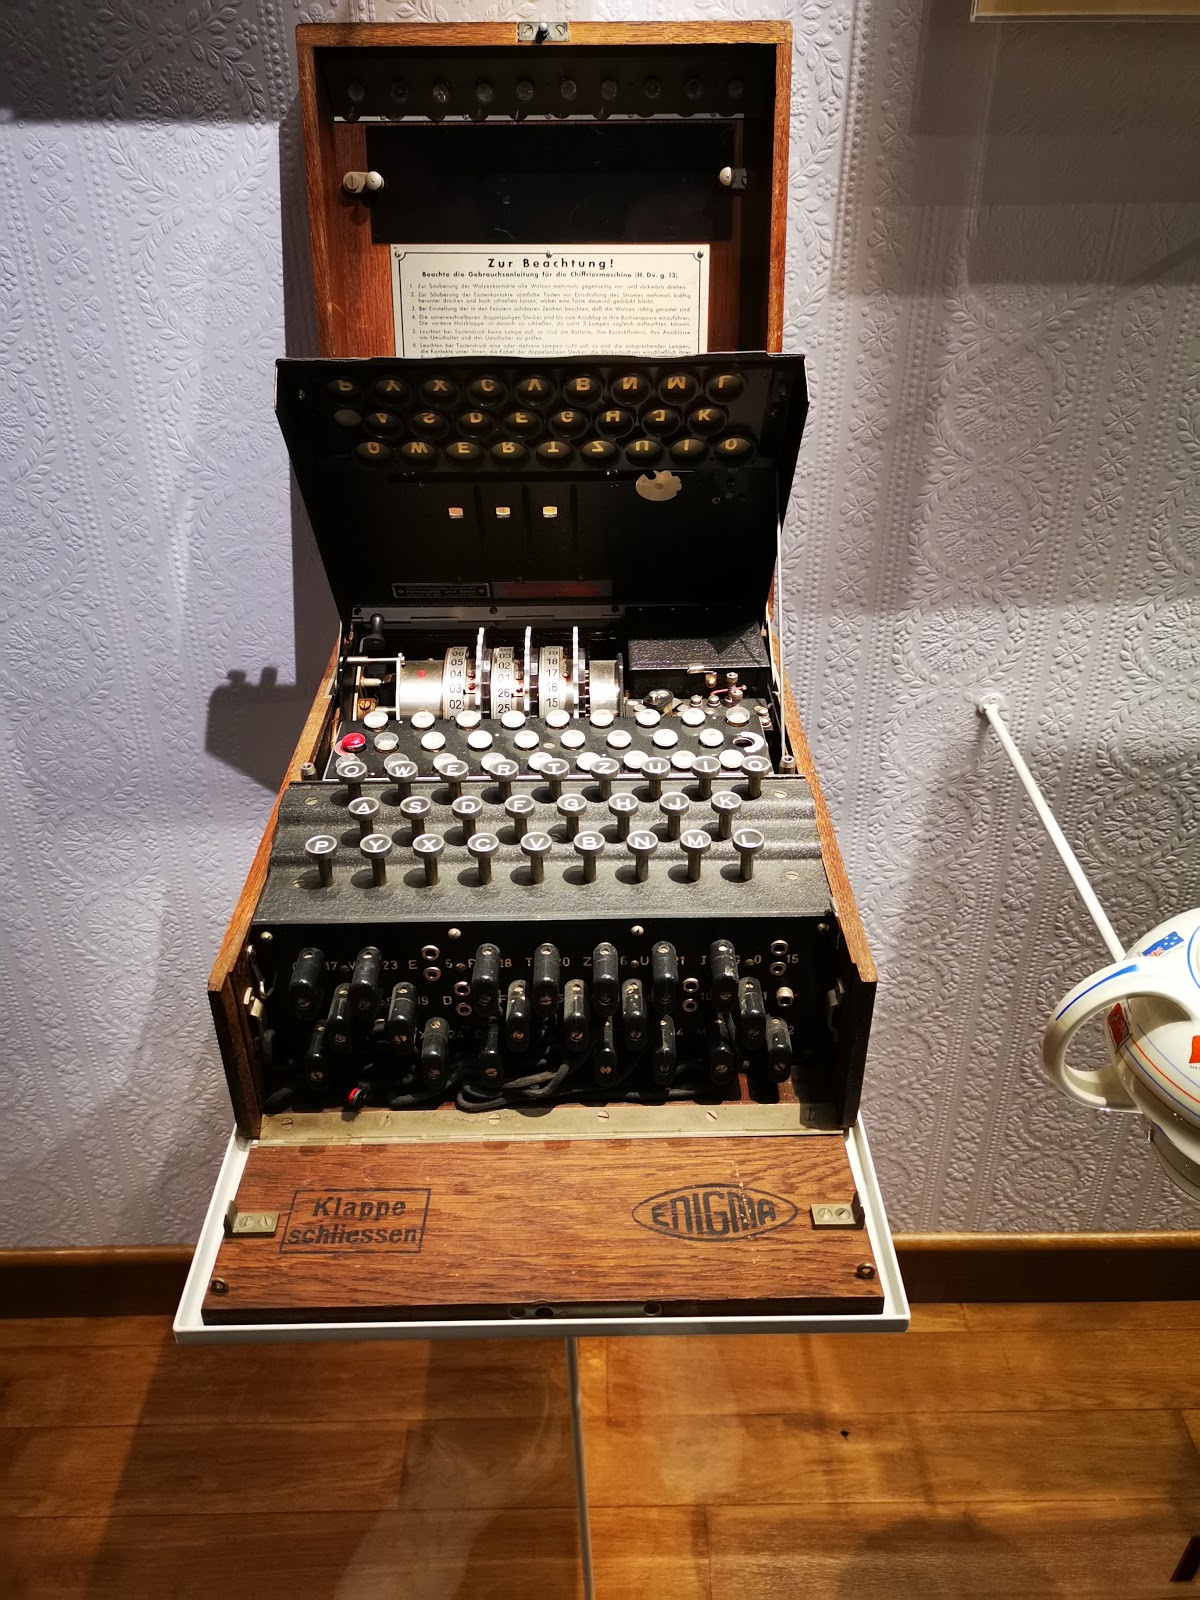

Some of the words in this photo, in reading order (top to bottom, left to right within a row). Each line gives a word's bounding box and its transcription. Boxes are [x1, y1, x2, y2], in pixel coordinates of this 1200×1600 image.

[488, 258, 514, 268] Zur
[522, 258, 614, 271] Beachtung!
[467, 271, 539, 280] Gebrauchsanleitung
[570, 271, 632, 279] Chiffriermaschine
[634, 271, 644, 281] (H.
[646, 271, 658, 279] Dv.
[659, 273, 666, 281] g.
[498, 661, 511, 670] 02
[450, 670, 462, 679] 04
[498, 674, 510, 682] 01
[546, 669, 557, 677] 17
[449, 683, 462, 694] 03
[546, 682, 557, 692] 16
[498, 688, 510, 698] 26
[449, 699, 462, 710] 02
[546, 698, 558, 708] 15
[498, 704, 510, 714] 25
[395, 766, 411, 775] W
[448, 765, 460, 775] E
[497, 765, 510, 774] R
[548, 764, 560, 773] T
[599, 764, 611, 773] Z
[649, 763, 661, 772] U
[704, 762, 708, 771] I
[357, 803, 370, 814] A
[409, 802, 421, 812] S
[461, 802, 475, 812] D
[514, 801, 527, 812] F
[564, 799, 579, 809] G
[617, 799, 631, 809] H
[668, 798, 681, 808] J
[720, 797, 734, 807] K
[315, 841, 329, 852] P
[369, 840, 384, 851] Y
[422, 840, 436, 850] X
[476, 839, 490, 850] C
[529, 838, 544, 849] V
[583, 837, 598, 848] B
[635, 837, 649, 848] N
[688, 836, 703, 846] M
[742, 835, 756, 845] L
[324, 961, 338, 971] 17
[382, 961, 398, 970] 23
[408, 960, 418, 970] E
[444, 959, 453, 969] 5
[582, 957, 593, 967] Z
[639, 955, 649, 966] U
[700, 955, 708, 966] I
[786, 953, 799, 964] 15
[313, 1197, 406, 1222] Klappe
[651, 1191, 776, 1236] ENIGMA
[289, 1224, 417, 1245] schliessen
